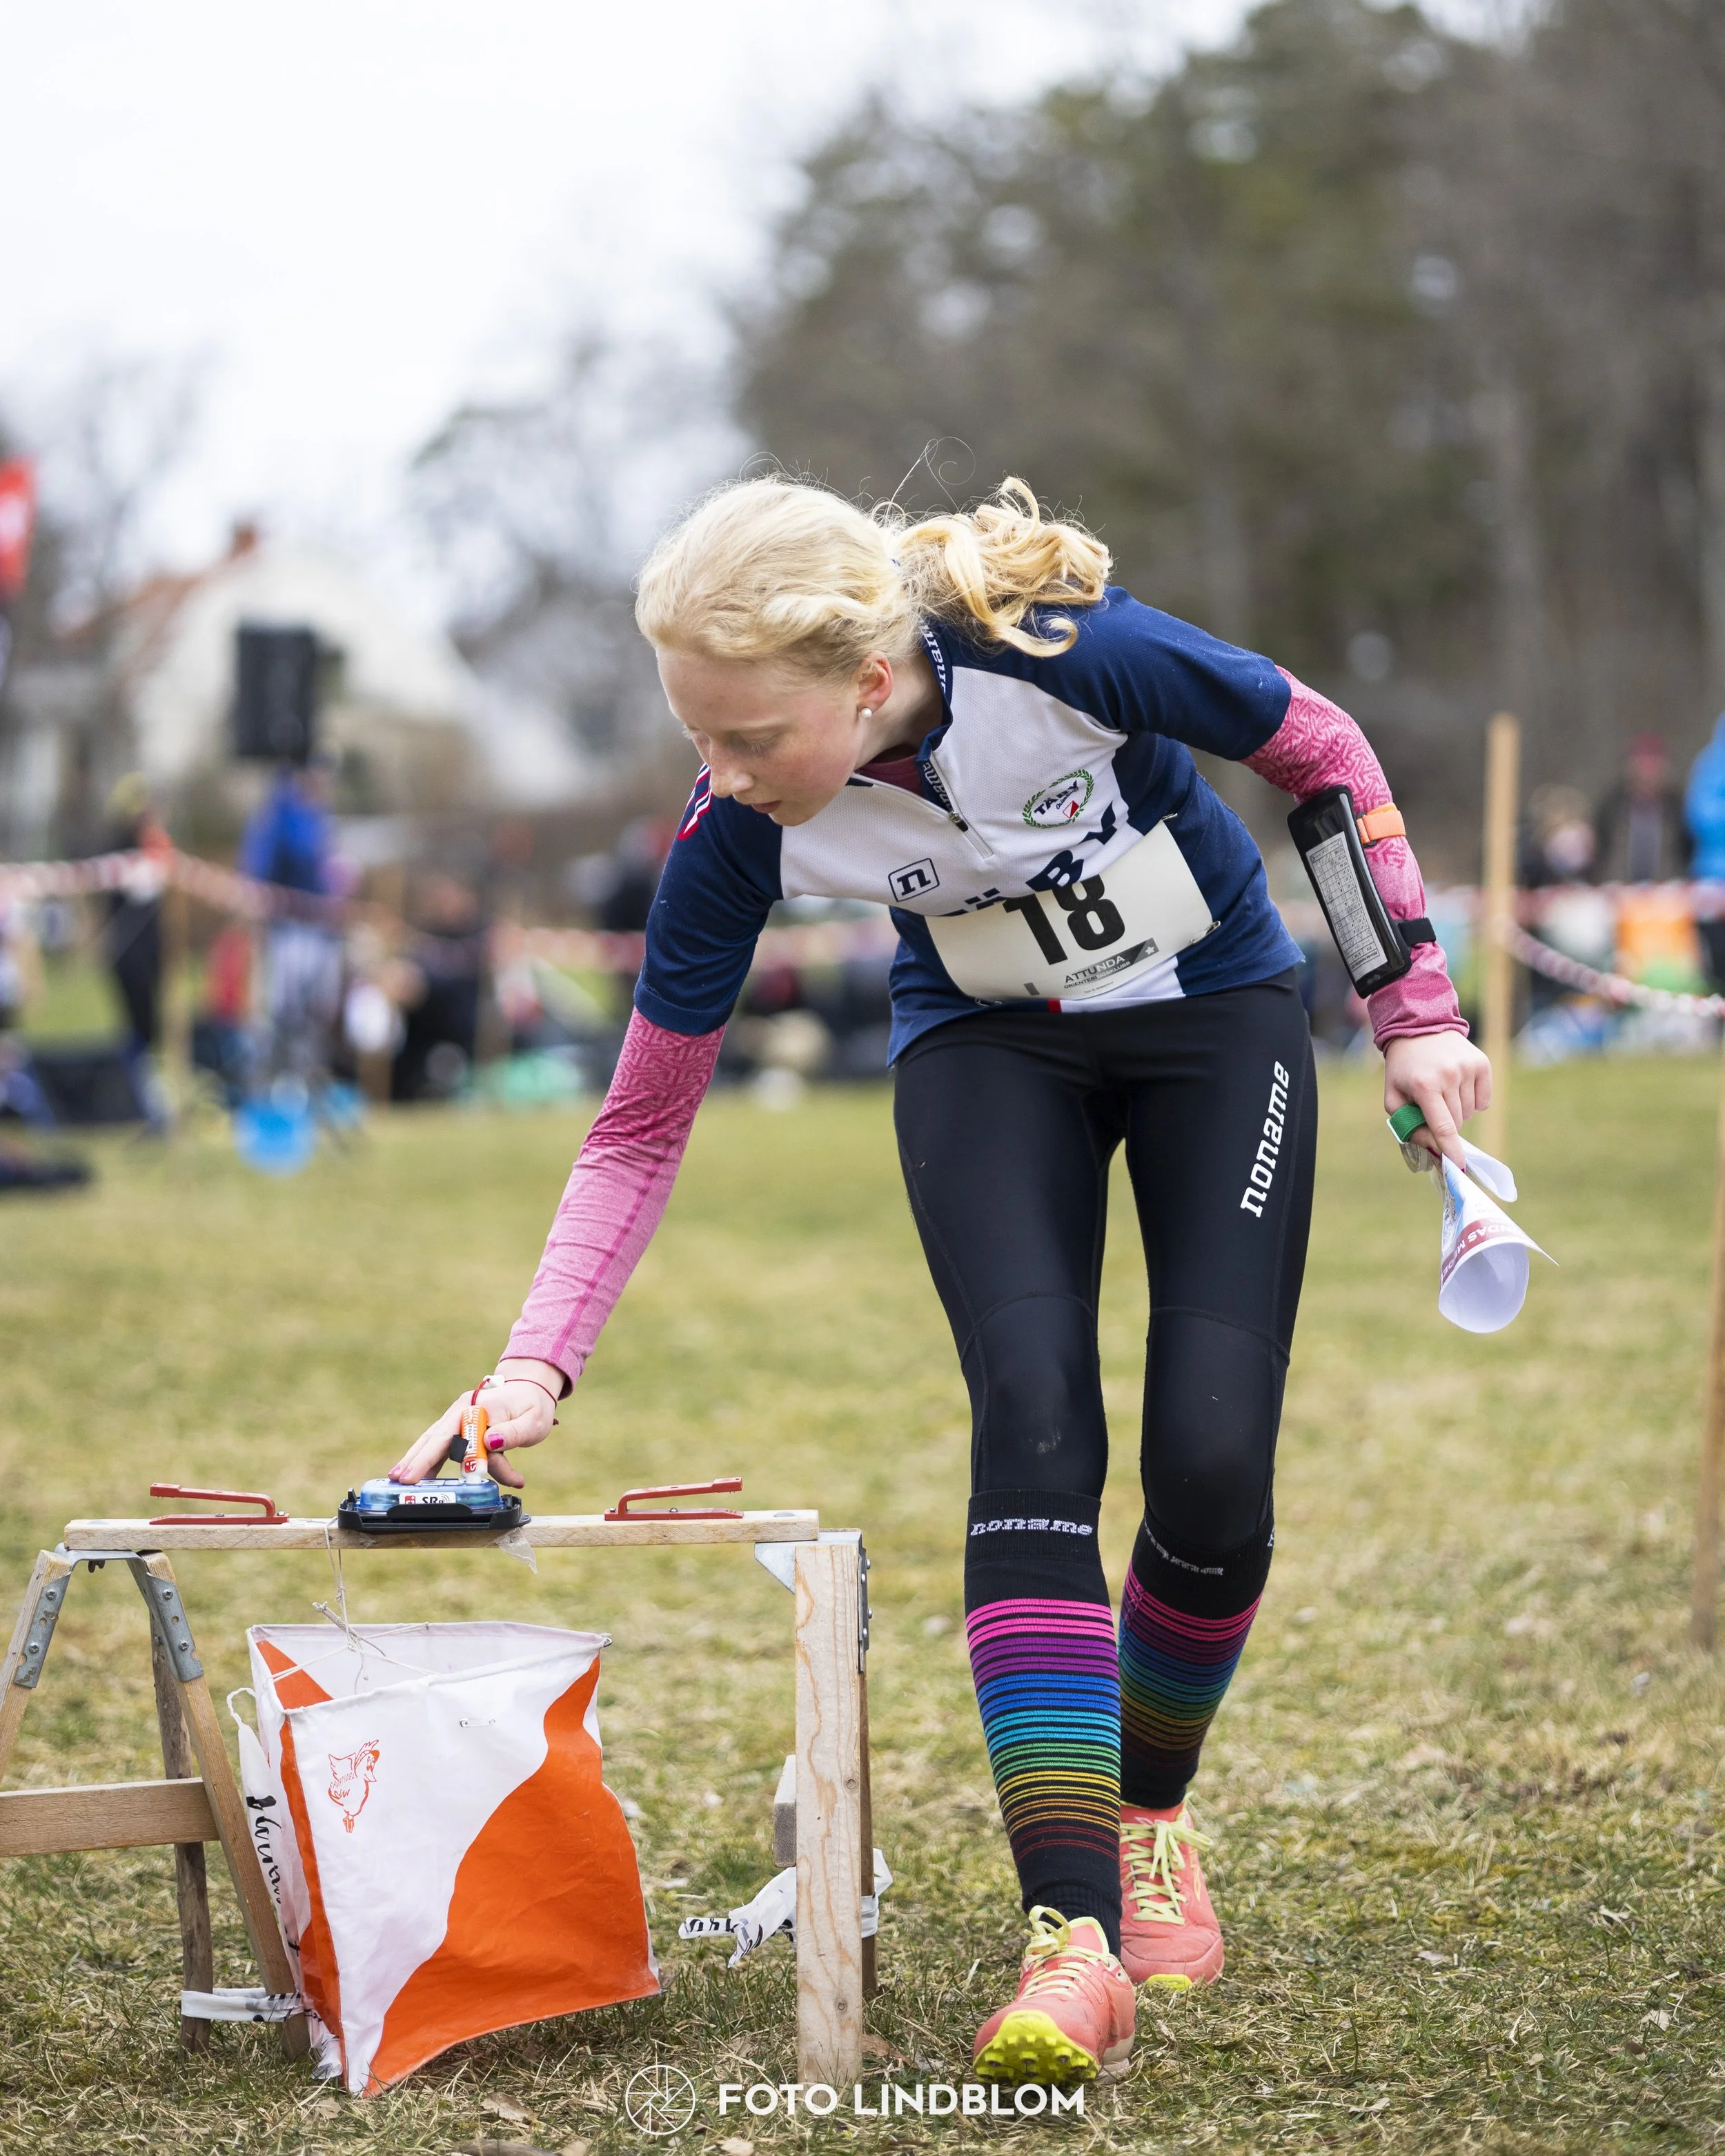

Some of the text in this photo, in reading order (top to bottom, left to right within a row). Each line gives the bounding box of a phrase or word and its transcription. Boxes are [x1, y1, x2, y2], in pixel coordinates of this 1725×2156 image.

[1003, 874, 1125, 966] 18
[1063, 961, 1131, 989] ORIENTERINGSKLUBB
[1065, 955, 1126, 983] ATTUNDA
[1240, 1060, 1290, 1218] noname
[1468, 1225, 1515, 1243] NDAS
[970, 1518, 1094, 1537] noname
